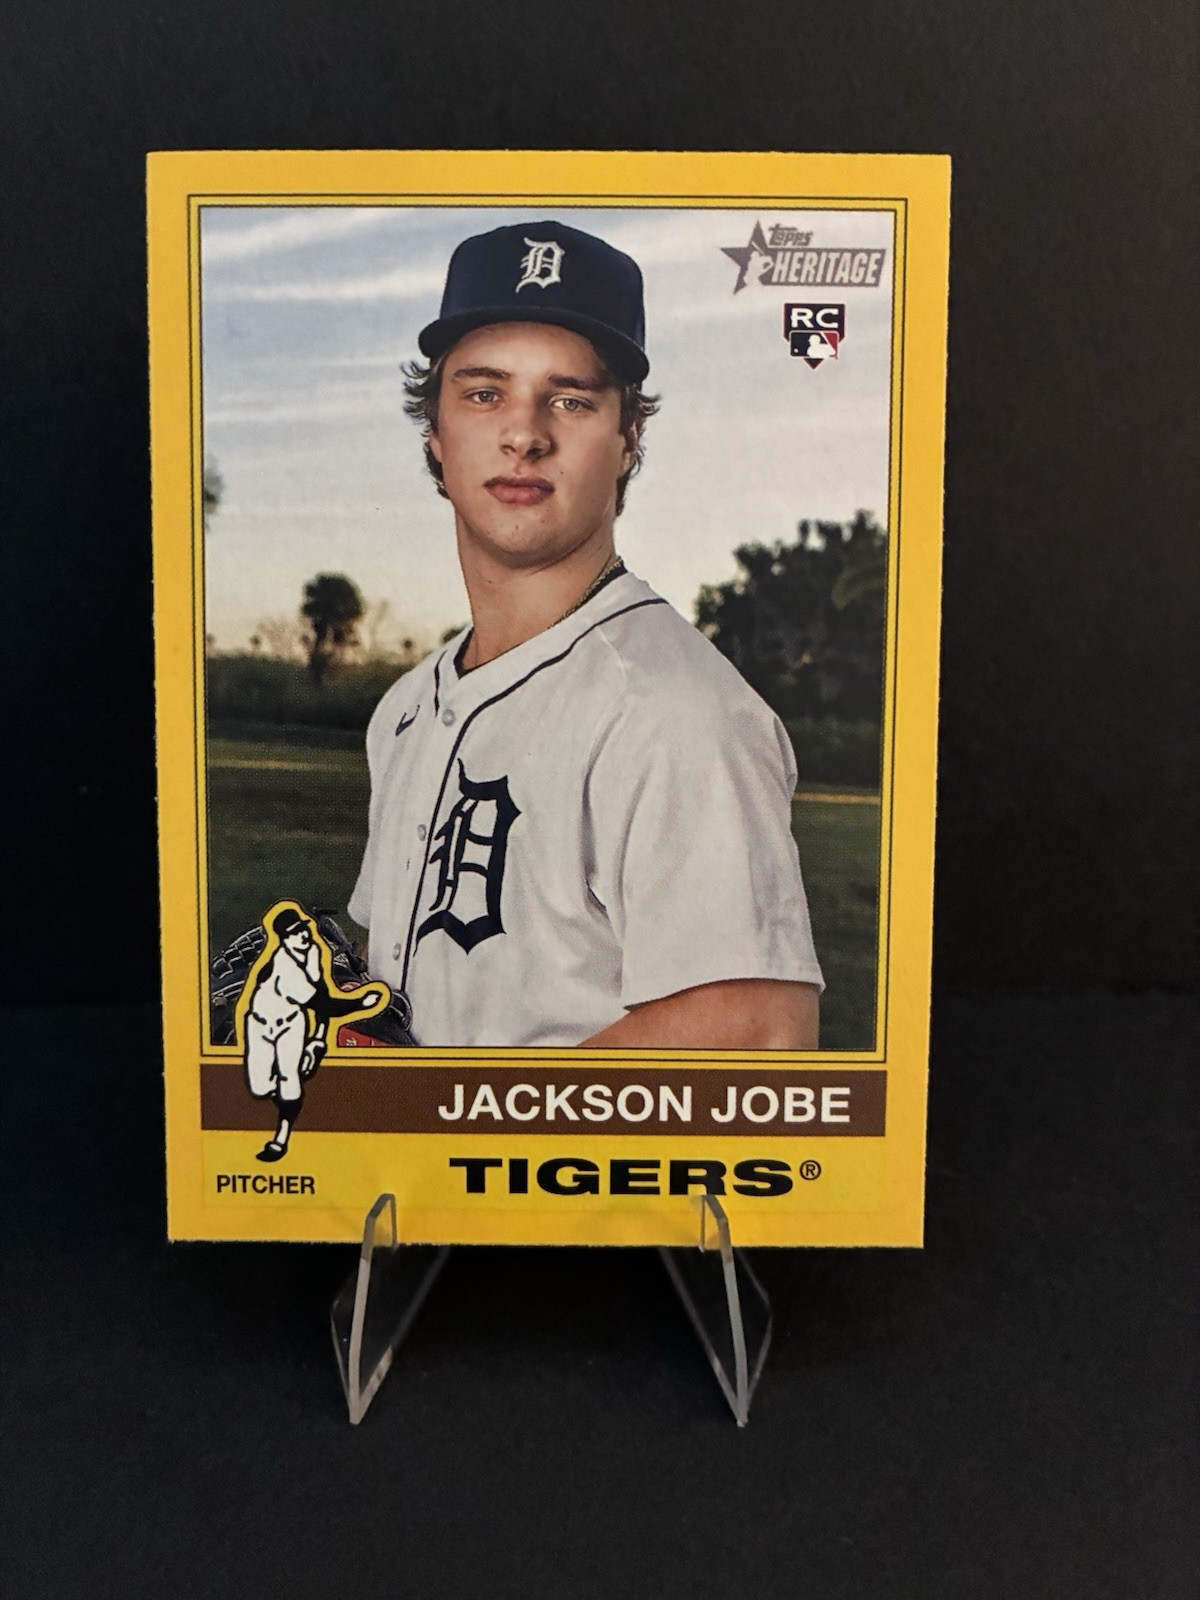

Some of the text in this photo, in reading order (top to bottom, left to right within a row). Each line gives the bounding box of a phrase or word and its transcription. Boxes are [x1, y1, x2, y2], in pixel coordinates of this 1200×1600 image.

[515, 237, 565, 293] D
[771, 251, 883, 285] HERITAGE
[790, 307, 839, 329] RC
[413, 757, 522, 956] D
[437, 1083, 851, 1123] JACKSON JOBE
[216, 1174, 316, 1195] PITCHER
